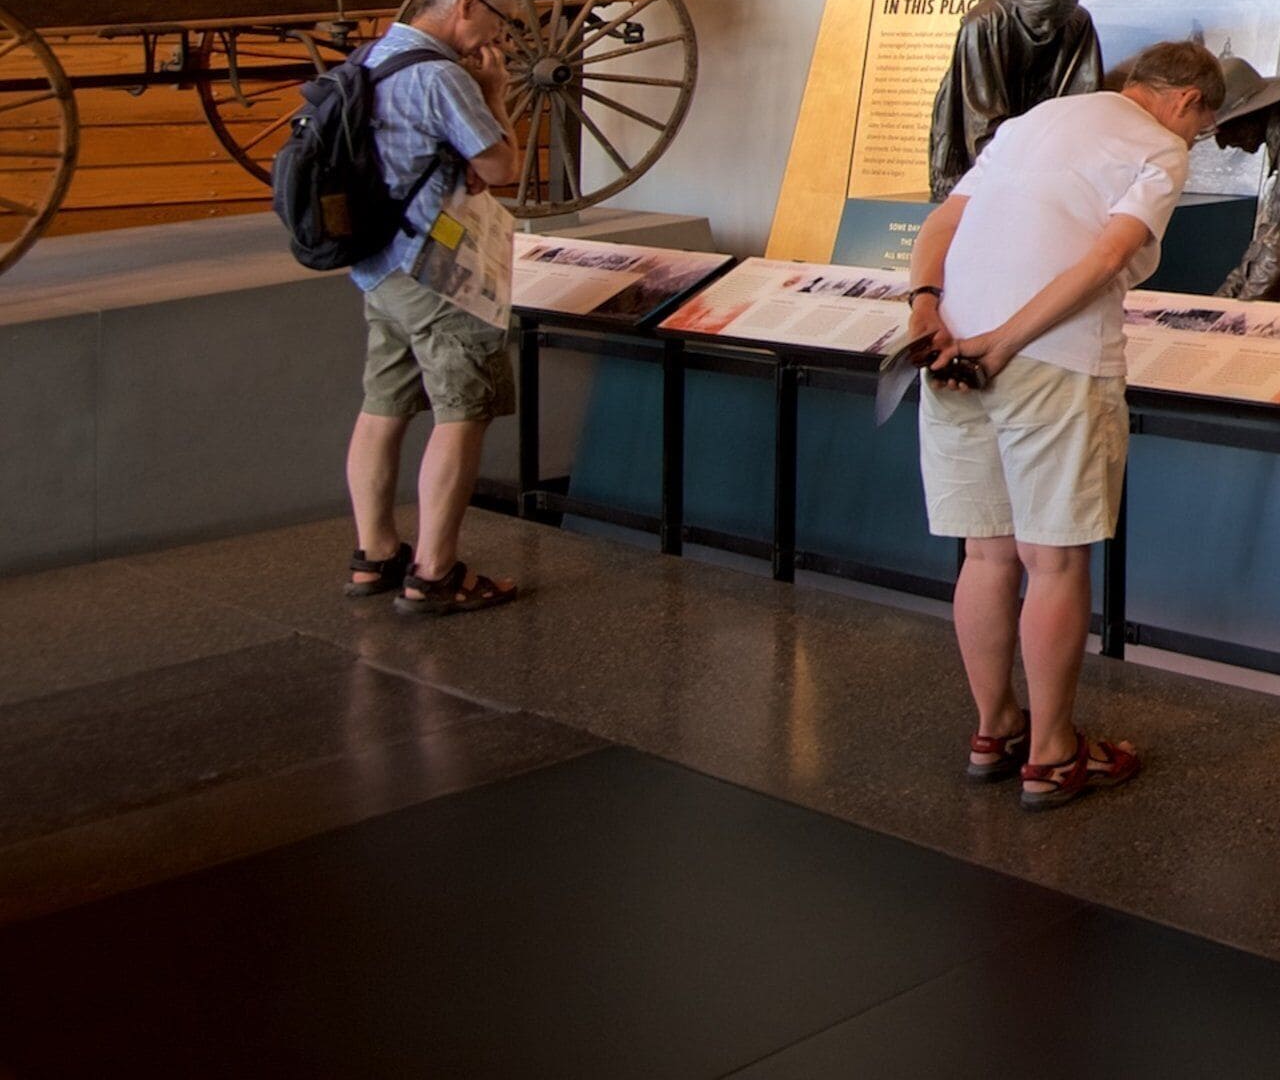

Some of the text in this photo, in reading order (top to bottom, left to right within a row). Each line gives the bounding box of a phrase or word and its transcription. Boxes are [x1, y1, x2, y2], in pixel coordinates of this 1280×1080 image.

[883, 0, 978, 16] IN THIS PLAC
